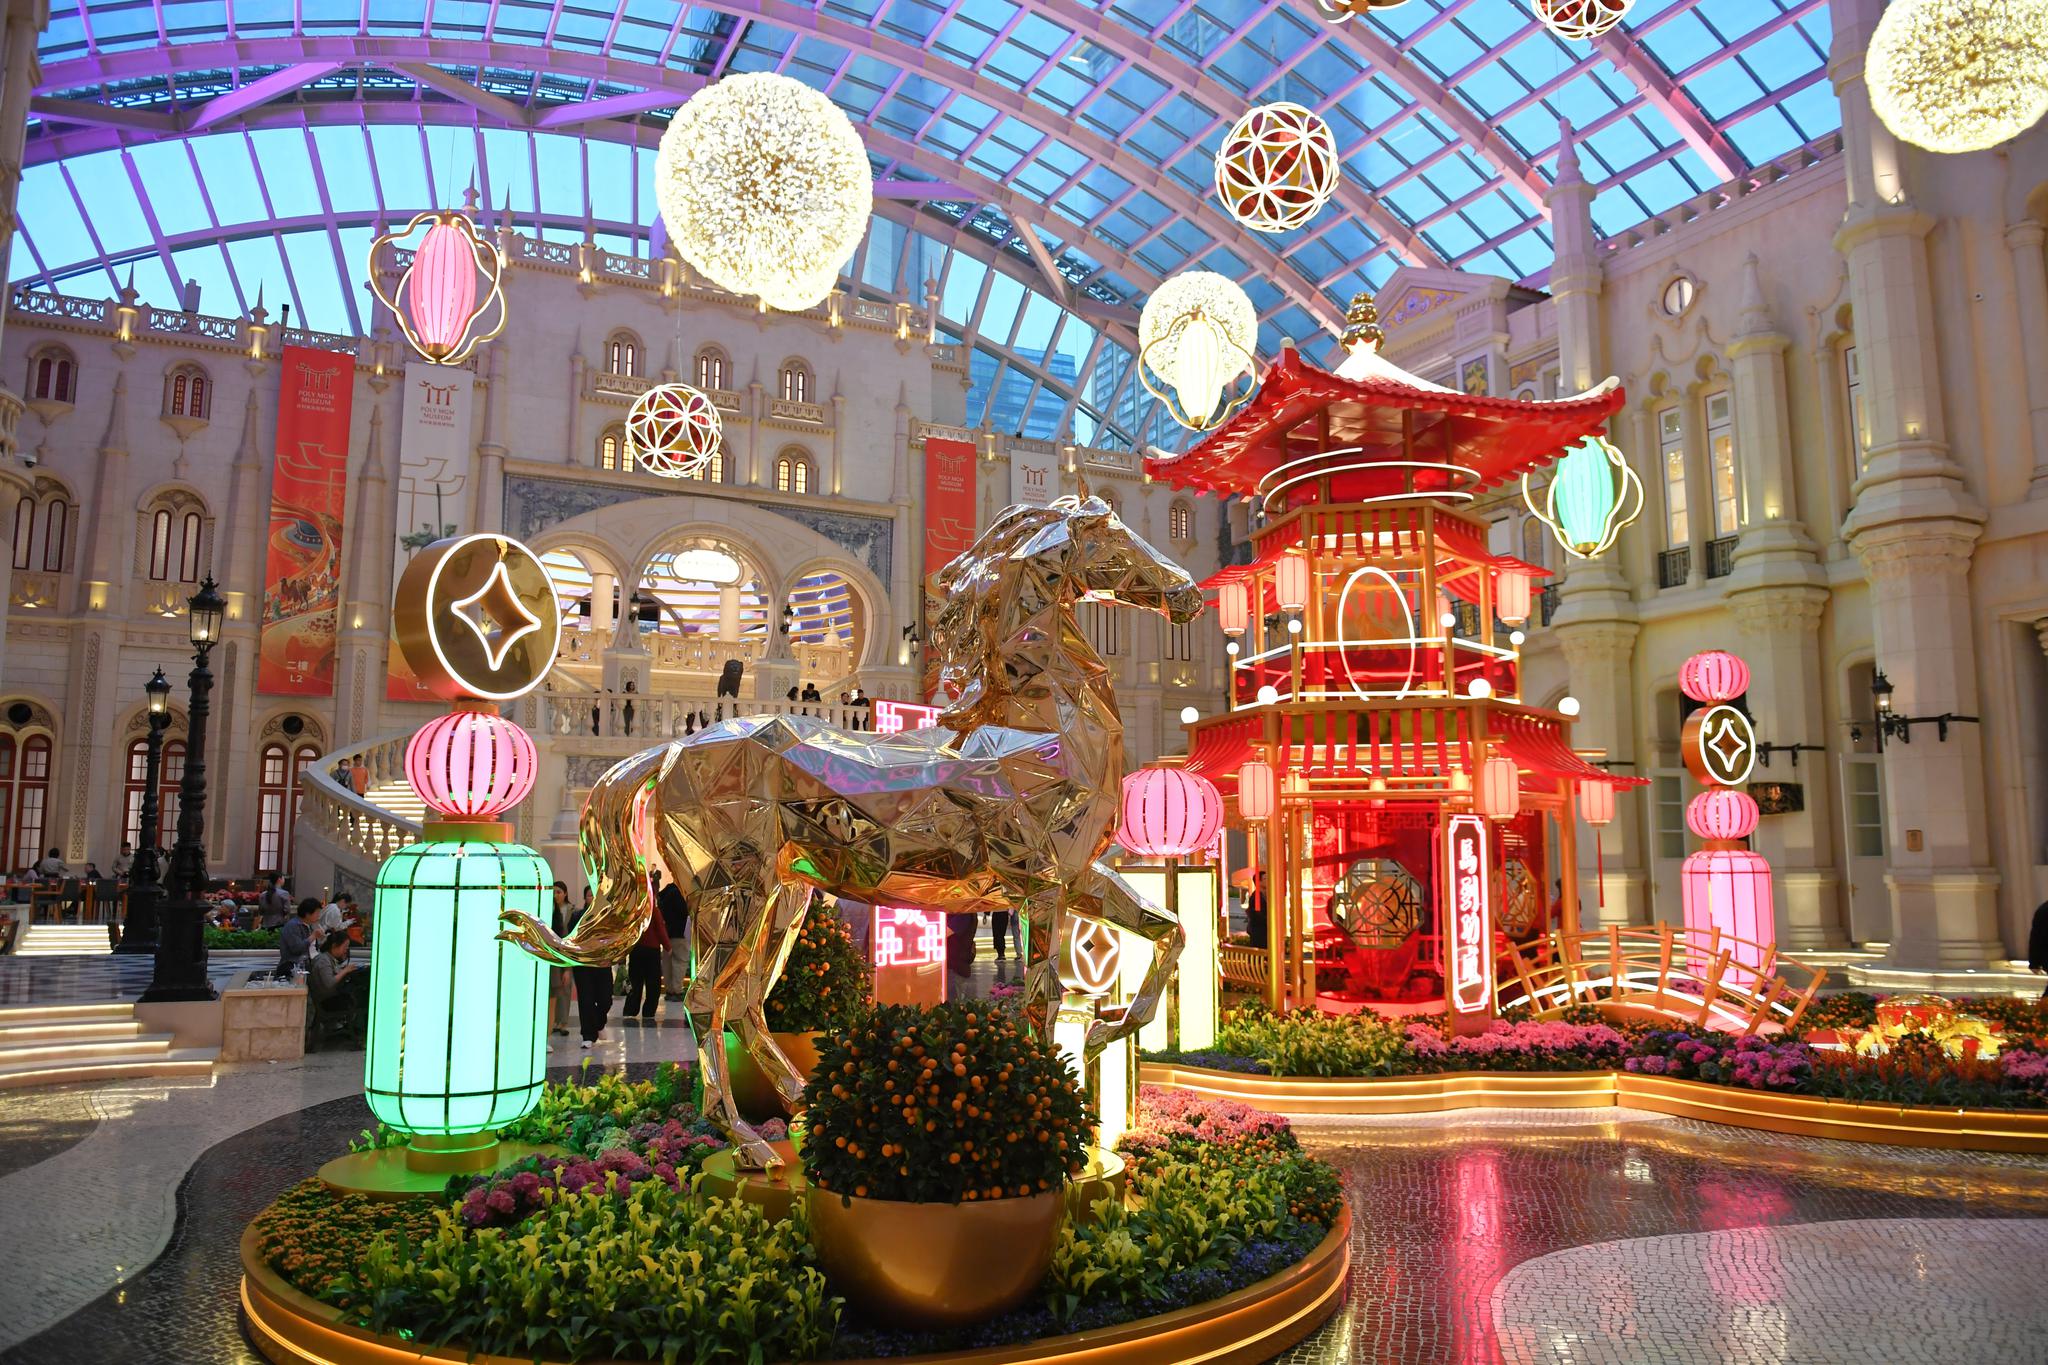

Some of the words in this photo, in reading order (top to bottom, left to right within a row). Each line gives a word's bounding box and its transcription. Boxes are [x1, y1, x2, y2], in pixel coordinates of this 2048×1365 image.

[317, 392, 335, 400] MGM
[301, 397, 331, 406] MUSEUM
[423, 412, 452, 421] MUSEUM
[290, 674, 303, 683] L2
